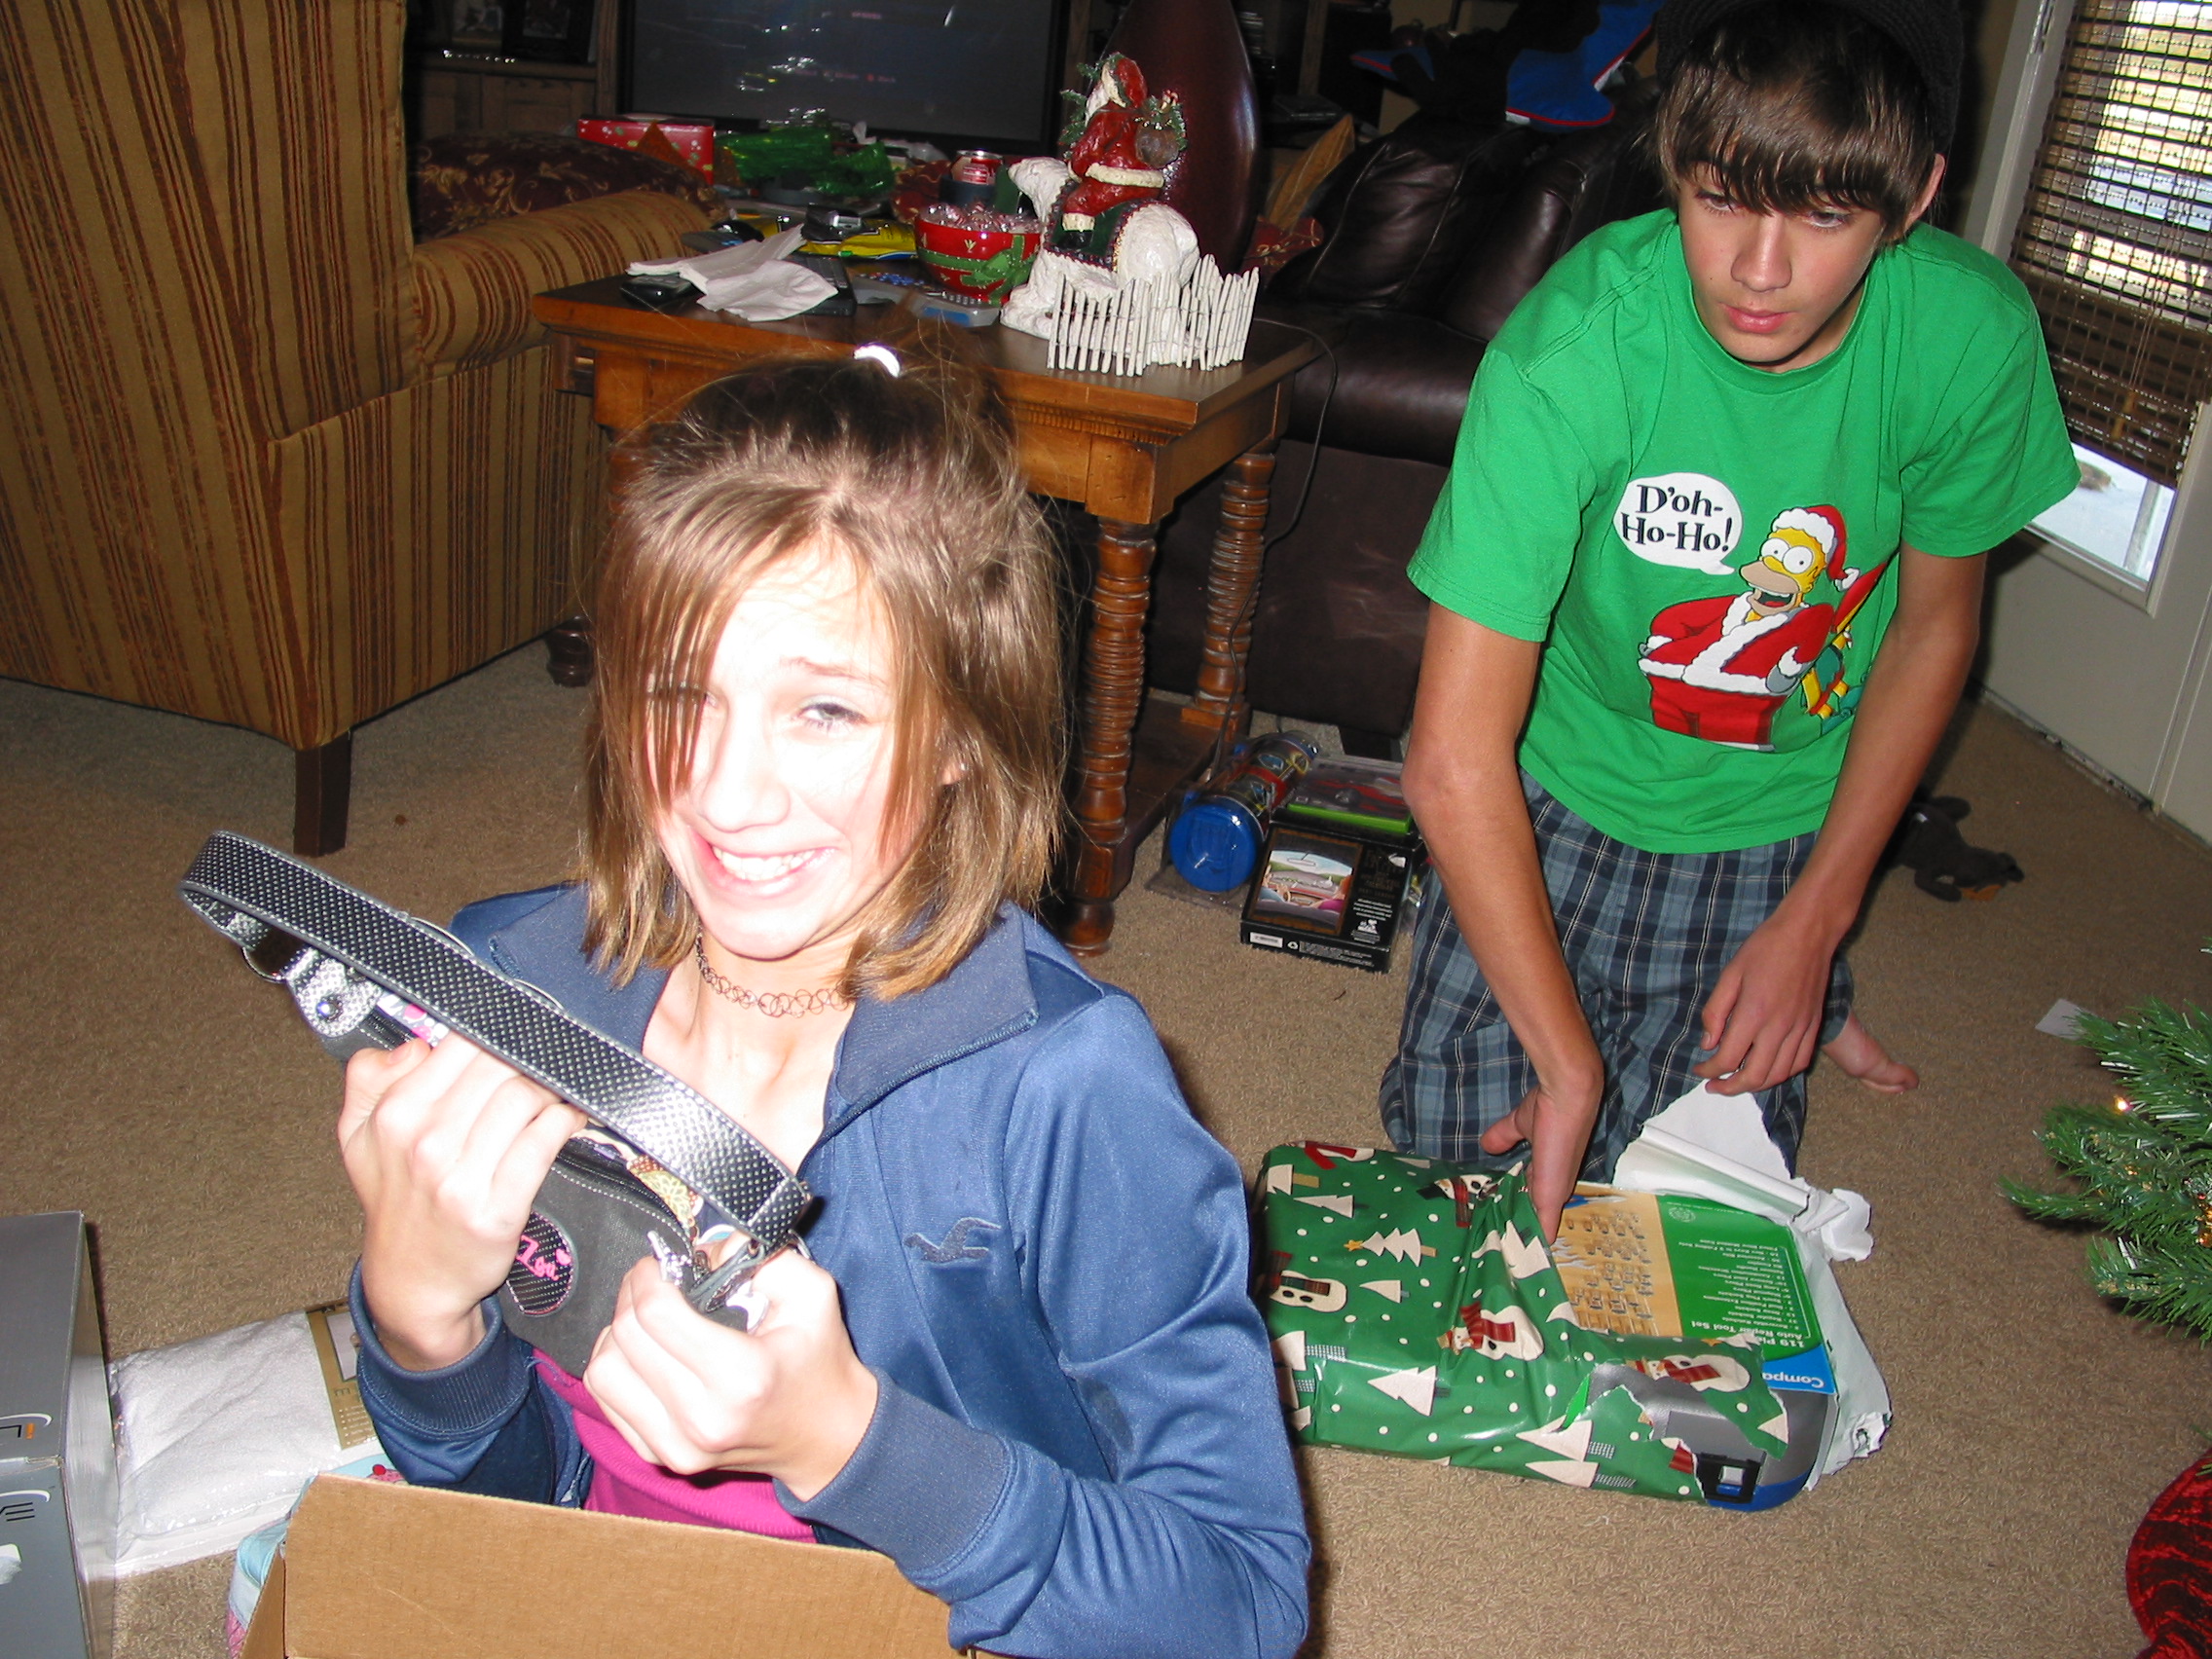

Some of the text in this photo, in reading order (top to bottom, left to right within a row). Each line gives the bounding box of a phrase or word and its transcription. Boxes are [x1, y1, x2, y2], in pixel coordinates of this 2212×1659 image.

[1636, 484, 1723, 517] D'oh-
[1621, 512, 1732, 553] Ho-Ho!
[1691, 1320, 1711, 1330] Set
[1713, 1324, 1737, 1333] Tool
[1777, 1332, 1802, 1341] Auto
